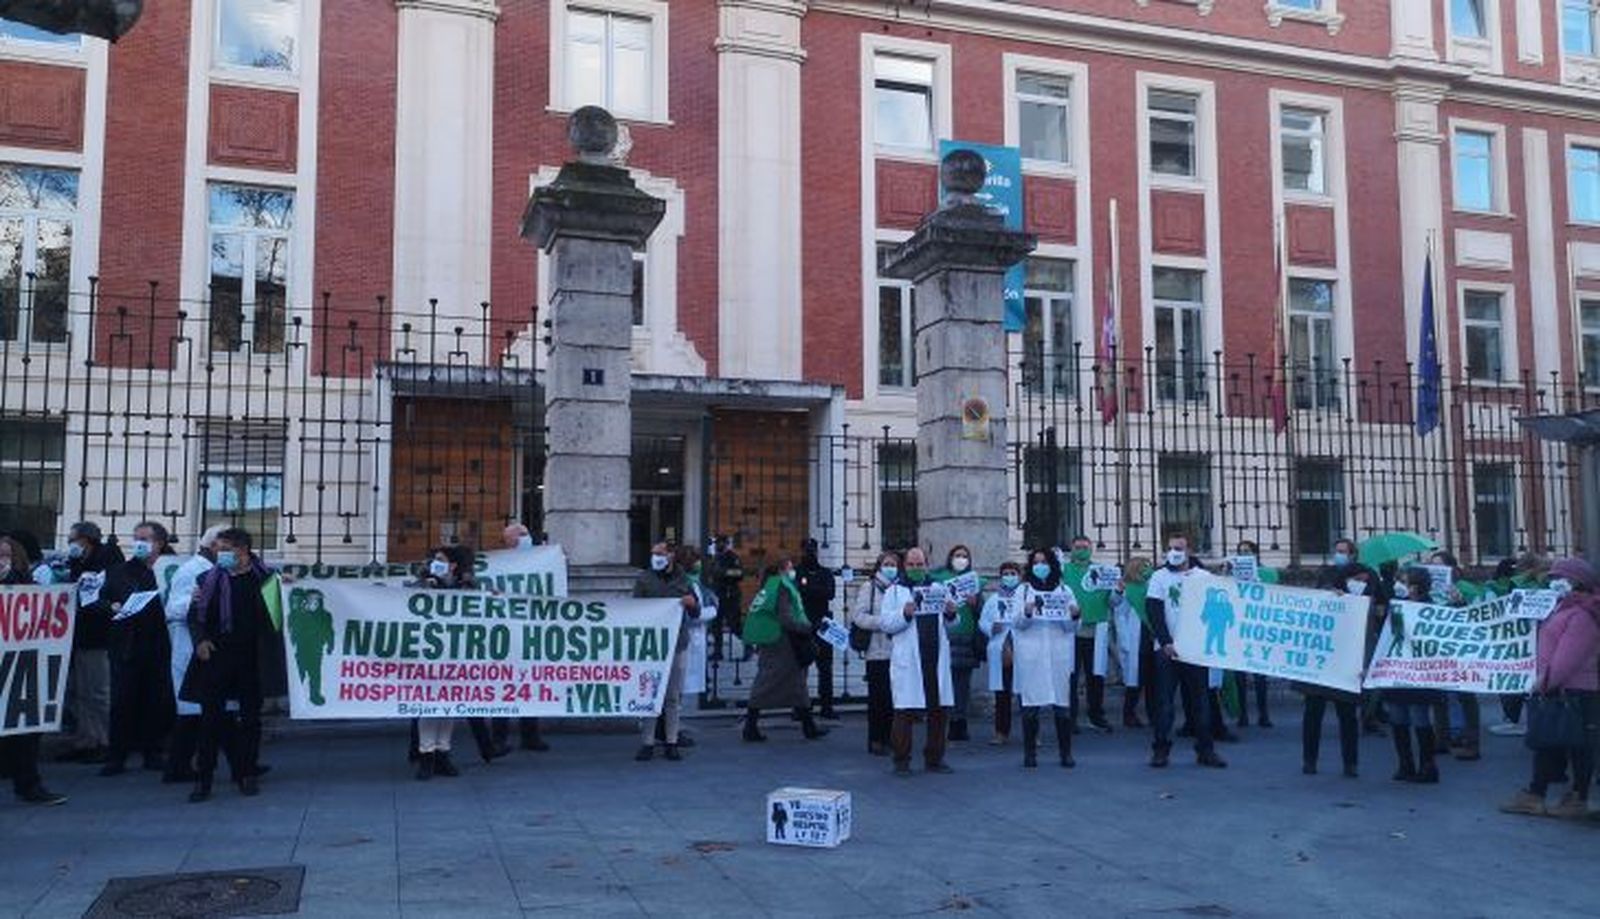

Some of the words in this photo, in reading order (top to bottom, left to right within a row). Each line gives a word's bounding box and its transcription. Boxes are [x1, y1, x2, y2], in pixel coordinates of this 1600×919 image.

[1237, 583, 1265, 601] YO
[0, 593, 69, 642] NCIAS
[408, 593, 607, 622] QUEREMOS
[1245, 602, 1335, 632] NUESTRO
[1417, 600, 1507, 624] QUEREM
[343, 620, 511, 660] NUESTRO
[1240, 621, 1334, 653] HOSPITAL
[1413, 618, 1532, 641] NUESTRO
[1411, 640, 1532, 660] HOSPITAL
[340, 660, 513, 682] HOSPITALIZACIÓN
[519, 670, 528, 682] y
[531, 665, 632, 682] URGENCIAS
[339, 683, 496, 702] HOSPITALARIAS
[503, 683, 532, 702] 24
[539, 684, 560, 702] h.
[566, 683, 622, 713] ¡YA!
